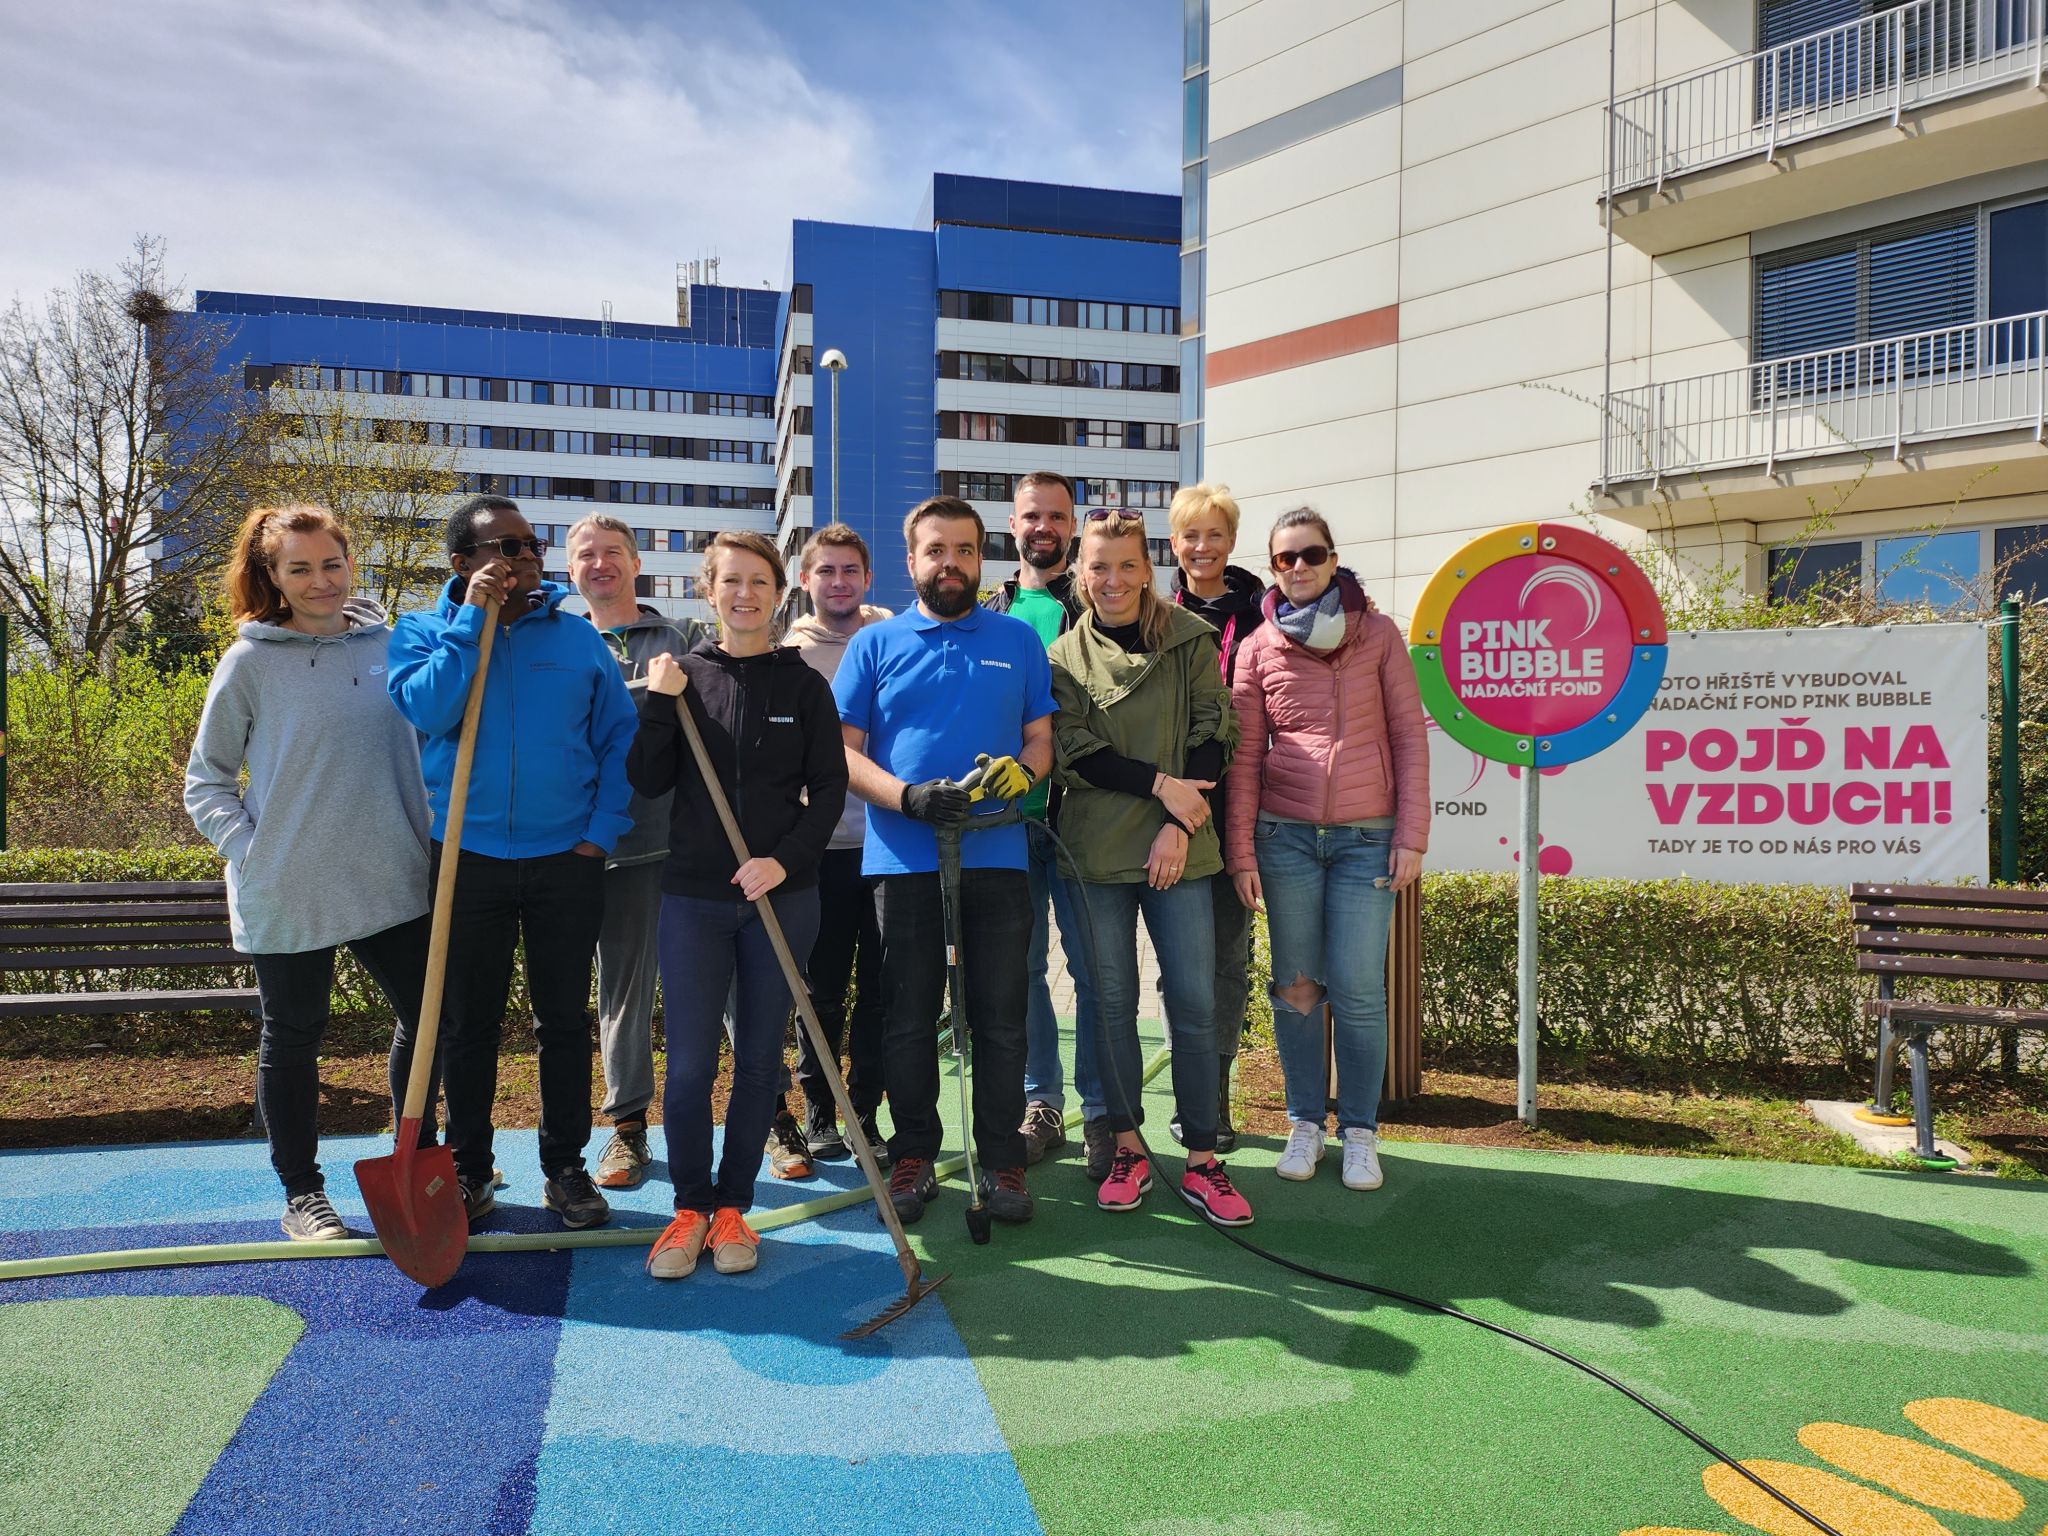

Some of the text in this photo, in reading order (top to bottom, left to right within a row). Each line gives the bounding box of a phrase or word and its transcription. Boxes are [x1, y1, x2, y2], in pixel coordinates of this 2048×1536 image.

[1460, 619, 1552, 650] PINK
[980, 659, 1012, 670] SAMSUNG
[1460, 648, 1604, 680] BUBBLE
[1461, 680, 1602, 698] NADAČNÍ FOND
[1659, 671, 1907, 691] OTO HŘIŠTĚ VYBUDOVAL
[1743, 695, 1797, 710] FOND
[1803, 693, 1850, 708] PINK
[1856, 691, 1931, 707] BUBBLE
[1646, 717, 1951, 772] POJĎ NA
[1435, 801, 1487, 816] FOND
[1646, 781, 1952, 825] VZDUCH!
[1648, 836, 1922, 854] TADY JE TO OD NÁS PRO VÁS
